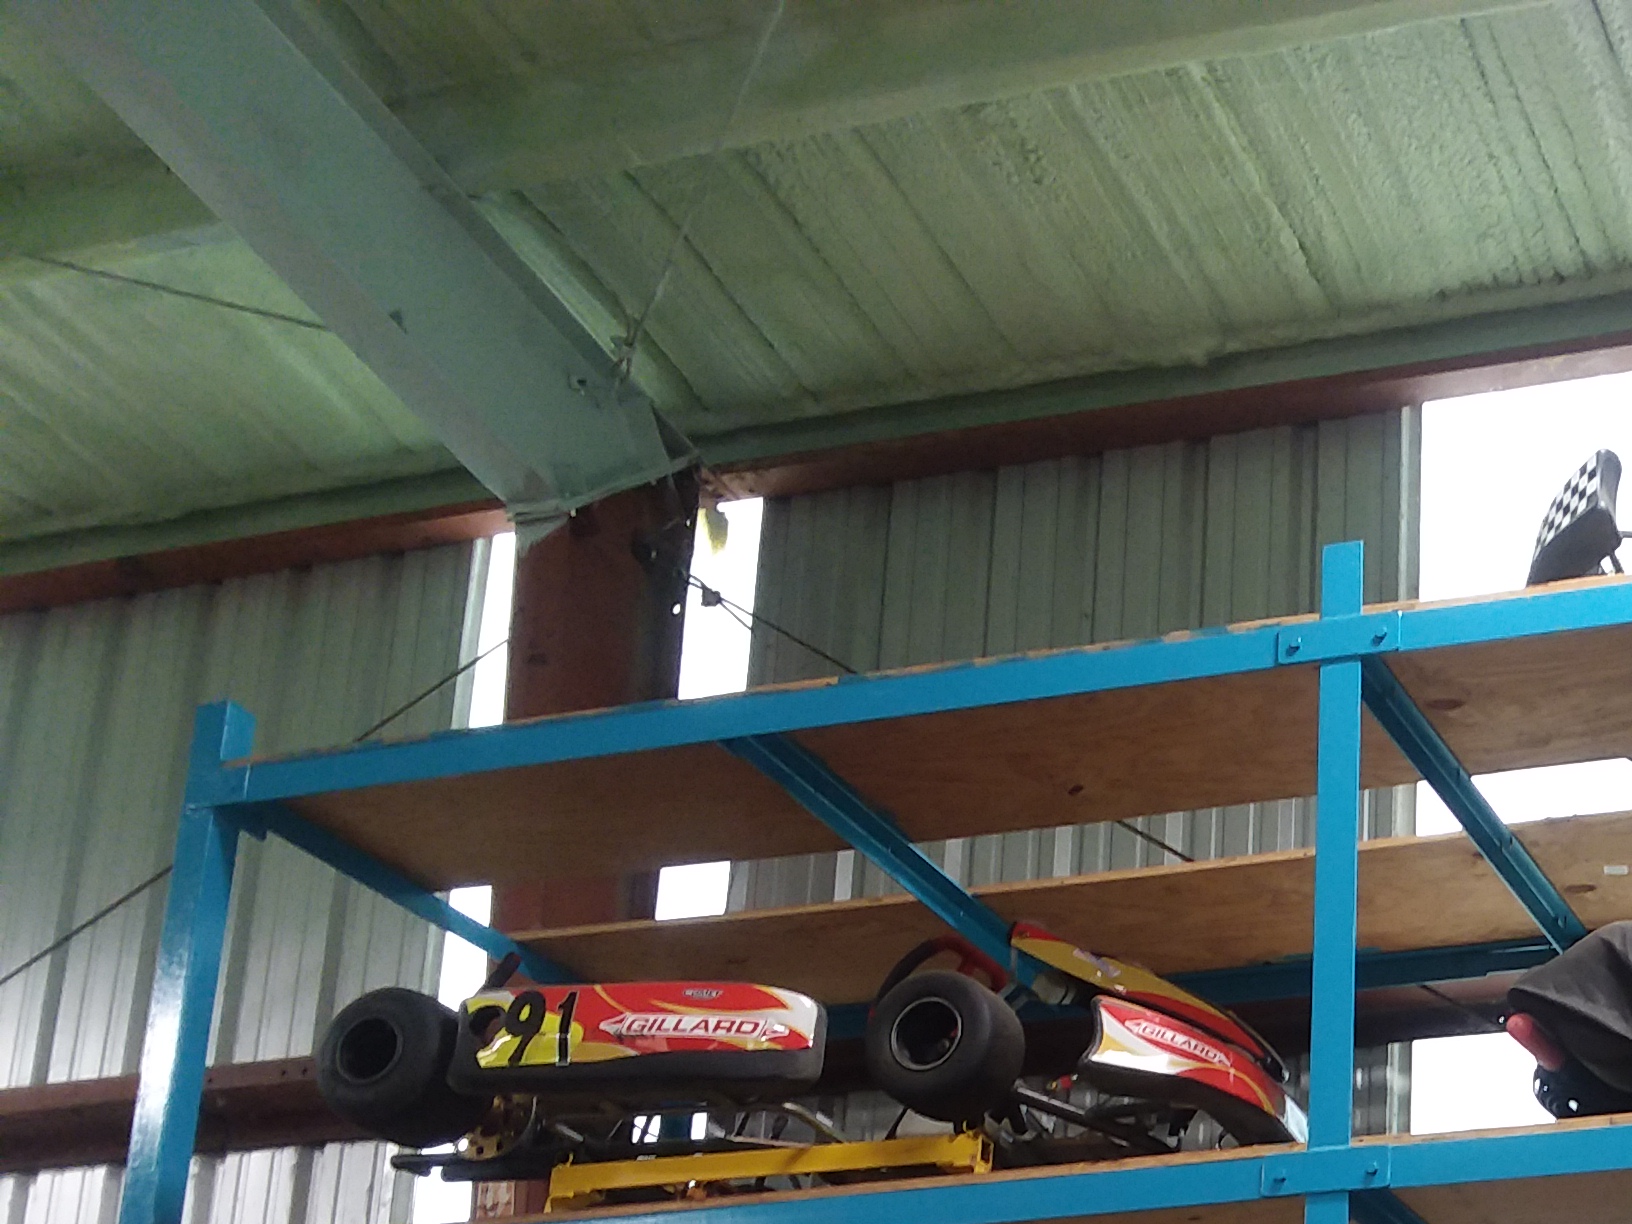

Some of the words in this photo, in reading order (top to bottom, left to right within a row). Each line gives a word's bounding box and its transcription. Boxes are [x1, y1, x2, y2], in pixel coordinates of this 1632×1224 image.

[504, 989, 579, 1066] 91
[625, 1016, 763, 1038] GILLARD
[1141, 1025, 1220, 1064] GILLARD
